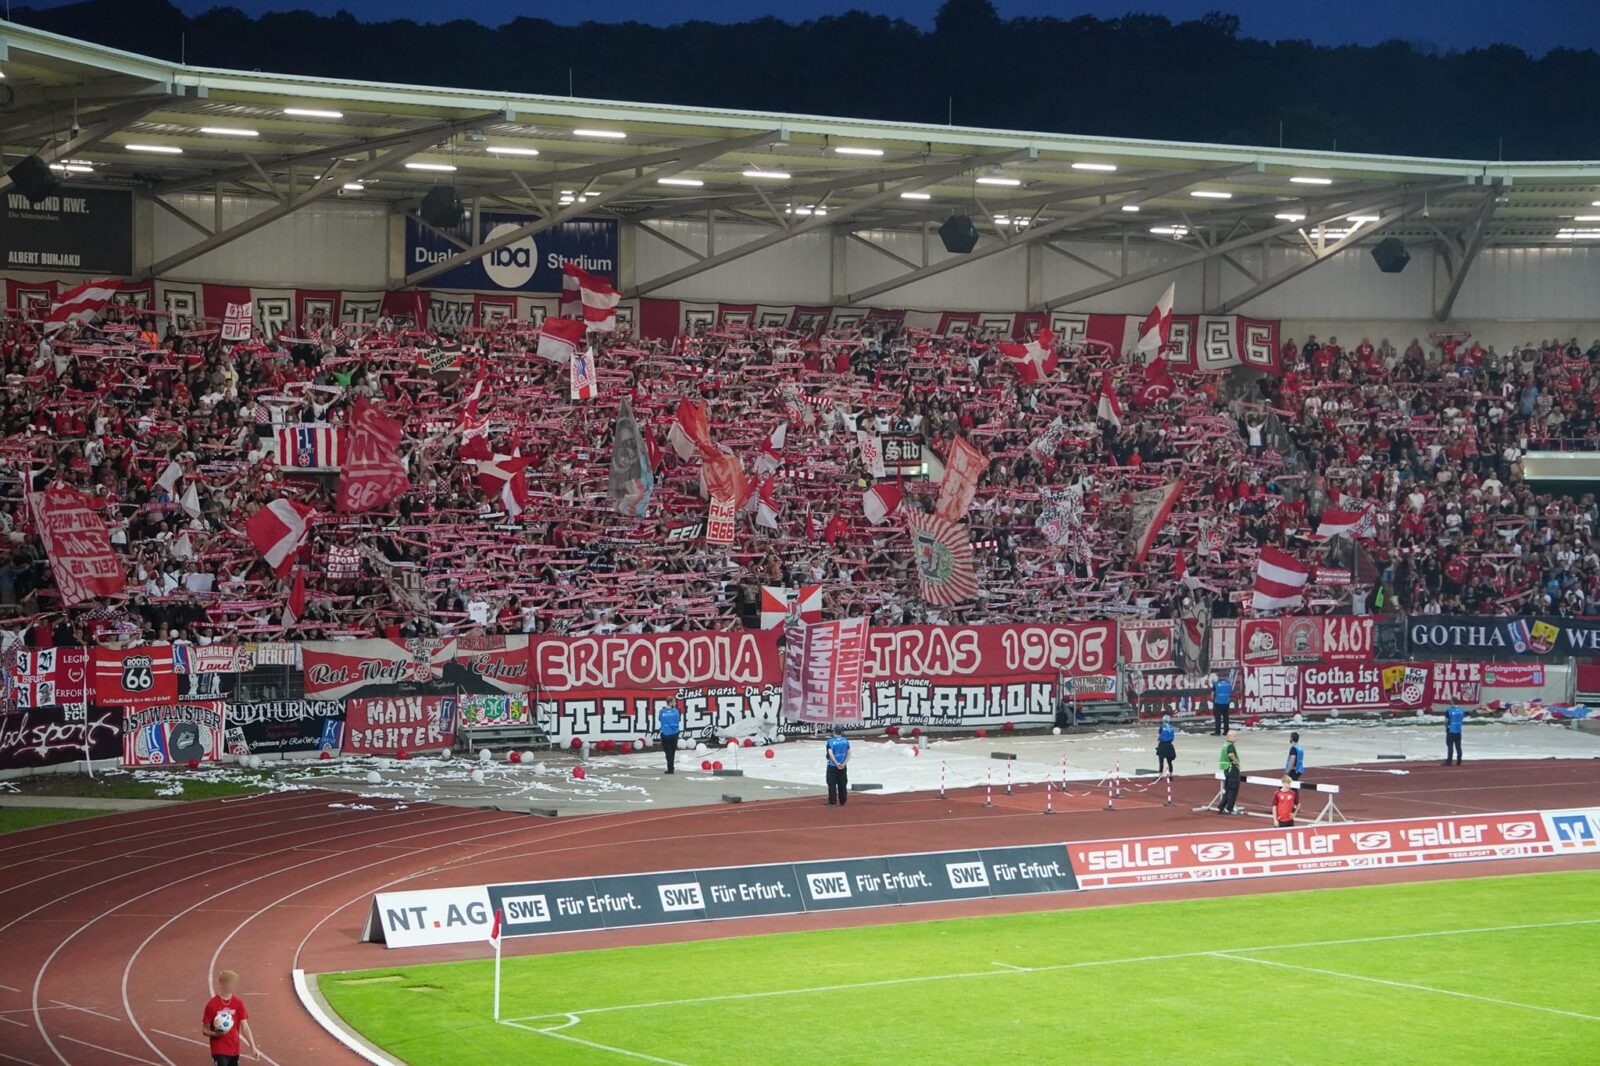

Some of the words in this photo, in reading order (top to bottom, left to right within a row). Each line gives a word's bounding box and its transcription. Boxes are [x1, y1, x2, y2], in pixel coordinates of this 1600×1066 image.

[8, 193, 30, 210] WIR
[63, 197, 90, 214] RWE.
[8, 250, 39, 264] ALBERT
[41, 252, 81, 267] BUNJAKU
[548, 252, 612, 272] Studium
[885, 440, 920, 461] Süd
[710, 504, 734, 518] RWE
[708, 520, 735, 539] 1966
[1323, 618, 1374, 654] KAOT
[1411, 624, 1506, 647] GOTHA
[63, 655, 90, 664] LEGIO
[127, 657, 150, 667] ROOTS
[196, 646, 233, 658] WEIMARER
[257, 649, 295, 665] BERLIN
[537, 634, 763, 692] ERFORDIA
[1001, 627, 1107, 672] 1996
[198, 660, 232, 672] Land
[309, 663, 349, 685] Rot
[360, 658, 408, 684] Weiß
[472, 653, 529, 679] Erfurt
[806, 624, 839, 718] KÄMPFER
[835, 622, 865, 719] TRÄUMER
[1304, 664, 1357, 685] Gotha
[1359, 664, 1379, 683] ist
[1410, 668, 1422, 676] FC
[1433, 663, 1481, 681] ELTE
[1485, 665, 1541, 674] Gebirgsrepublik
[22, 674, 45, 683] ERFURT
[126, 668, 152, 689] 66
[1148, 674, 1173, 690] LOS
[1244, 665, 1299, 697] WEST
[1405, 674, 1425, 683] RWE
[56, 688, 96, 698] ERFORDIA
[676, 687, 703, 700] Einst
[707, 686, 736, 697] warst
[1306, 684, 1380, 705] Rot-Weiß
[123, 704, 221, 735] OSTWANSTER
[366, 696, 423, 725] MAIN
[908, 715, 929, 725] ewig
[934, 716, 963, 726] sehnen
[351, 722, 444, 749] FIGHTER
[953, 866, 985, 884] SWE
[993, 864, 1017, 881] Für
[1020, 860, 1066, 880] Erfurt.
[1296, 861, 1343, 870] TEAM.SPORT
[812, 876, 847, 895] SWE
[855, 873, 881, 892] Für
[885, 870, 932, 890] Erfurt.
[1135, 872, 1184, 882] TEAM.SPORT
[663, 887, 700, 908] SWE
[710, 884, 737, 904] Für
[740, 880, 791, 901] Erfurt.
[507, 898, 546, 919] SWE
[556, 895, 585, 916] Für
[586, 891, 642, 913] Erfurt.
[386, 901, 487, 932] NT.AG
